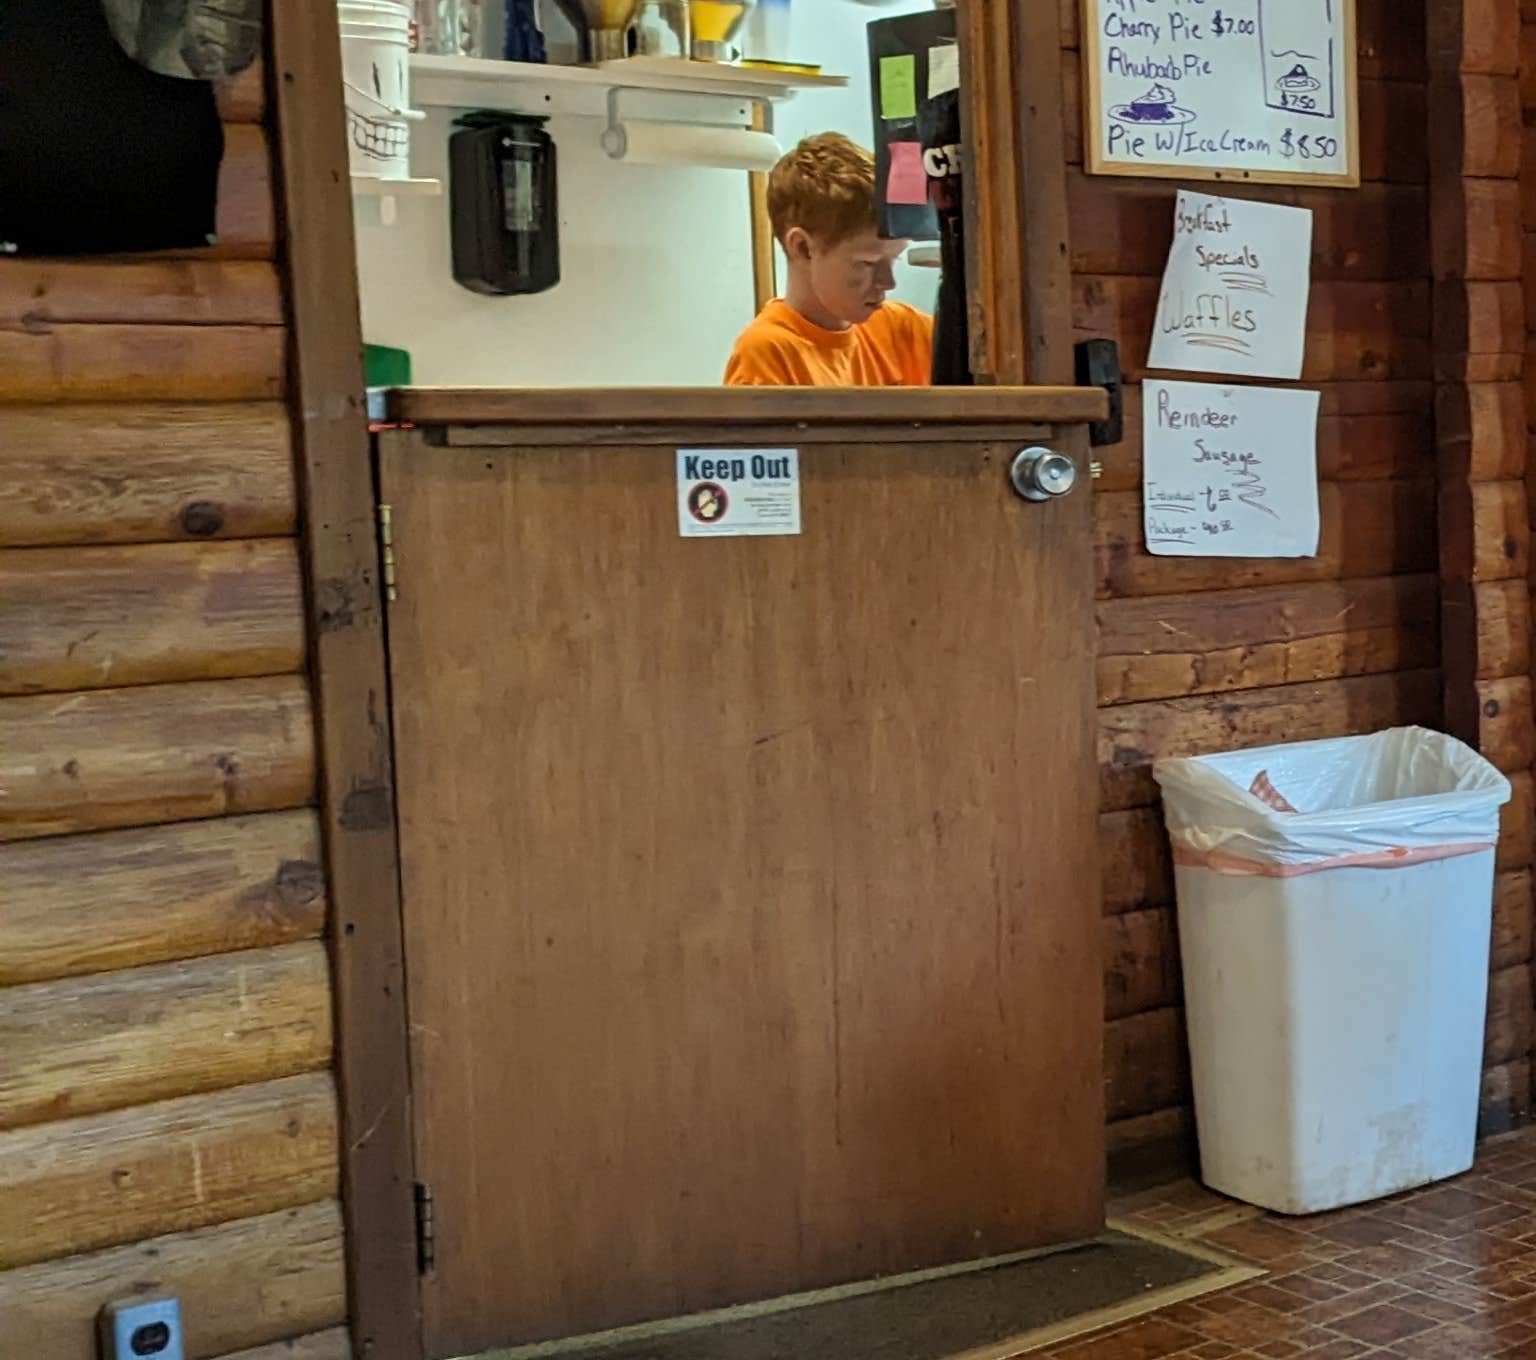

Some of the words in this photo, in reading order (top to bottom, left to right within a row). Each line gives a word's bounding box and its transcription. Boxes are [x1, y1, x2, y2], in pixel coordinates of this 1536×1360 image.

[1168, 11, 1203, 41] Pie
[1211, 9, 1255, 38] $7.00
[1184, 53, 1213, 77] Pie
[1108, 124, 1145, 158] Pie
[1196, 244, 1260, 272] Specials
[1163, 293, 1256, 333] Waffles
[1158, 388, 1239, 430] Reindeer
[684, 455, 745, 482] Keep
[751, 454, 791, 480] Out
[1193, 438, 1262, 476] Sausage
